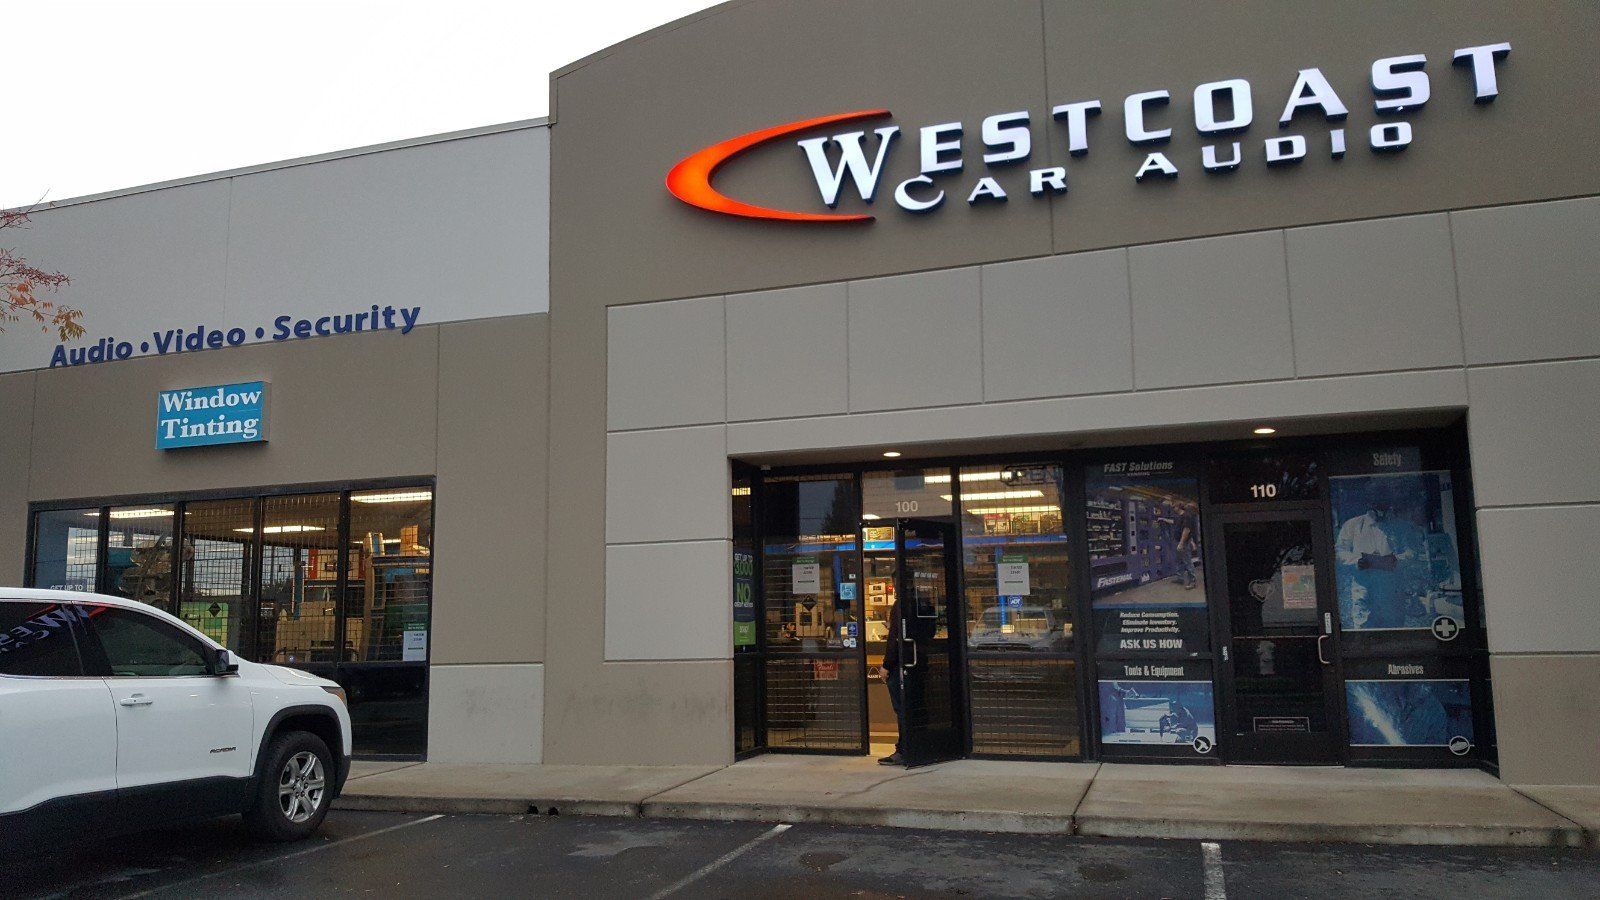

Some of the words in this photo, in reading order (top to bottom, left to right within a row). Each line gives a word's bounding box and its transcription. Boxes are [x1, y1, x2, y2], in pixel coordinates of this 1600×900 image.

[797, 41, 1512, 209] WESTCOAST
[894, 166, 1068, 216] CAR
[1135, 121, 1413, 183] AUDIO
[49, 337, 133, 368] Audio
[153, 325, 246, 355] Video
[272, 304, 421, 334] Security
[161, 387, 262, 413] Window
[160, 414, 260, 440] Tinting
[1103, 462, 1128, 473] FAST
[1128, 460, 1174, 472] Solutions
[1250, 484, 1277, 498] 110
[895, 500, 919, 513] 100
[1119, 639, 1141, 649] ASK
[1142, 639, 1157, 649] US
[1159, 639, 1183, 649] HOW
[1123, 665, 1143, 677] Tools
[1143, 665, 1150, 677] &
[1151, 665, 1185, 678] Equipment
[1387, 664, 1424, 675] Abrasives
